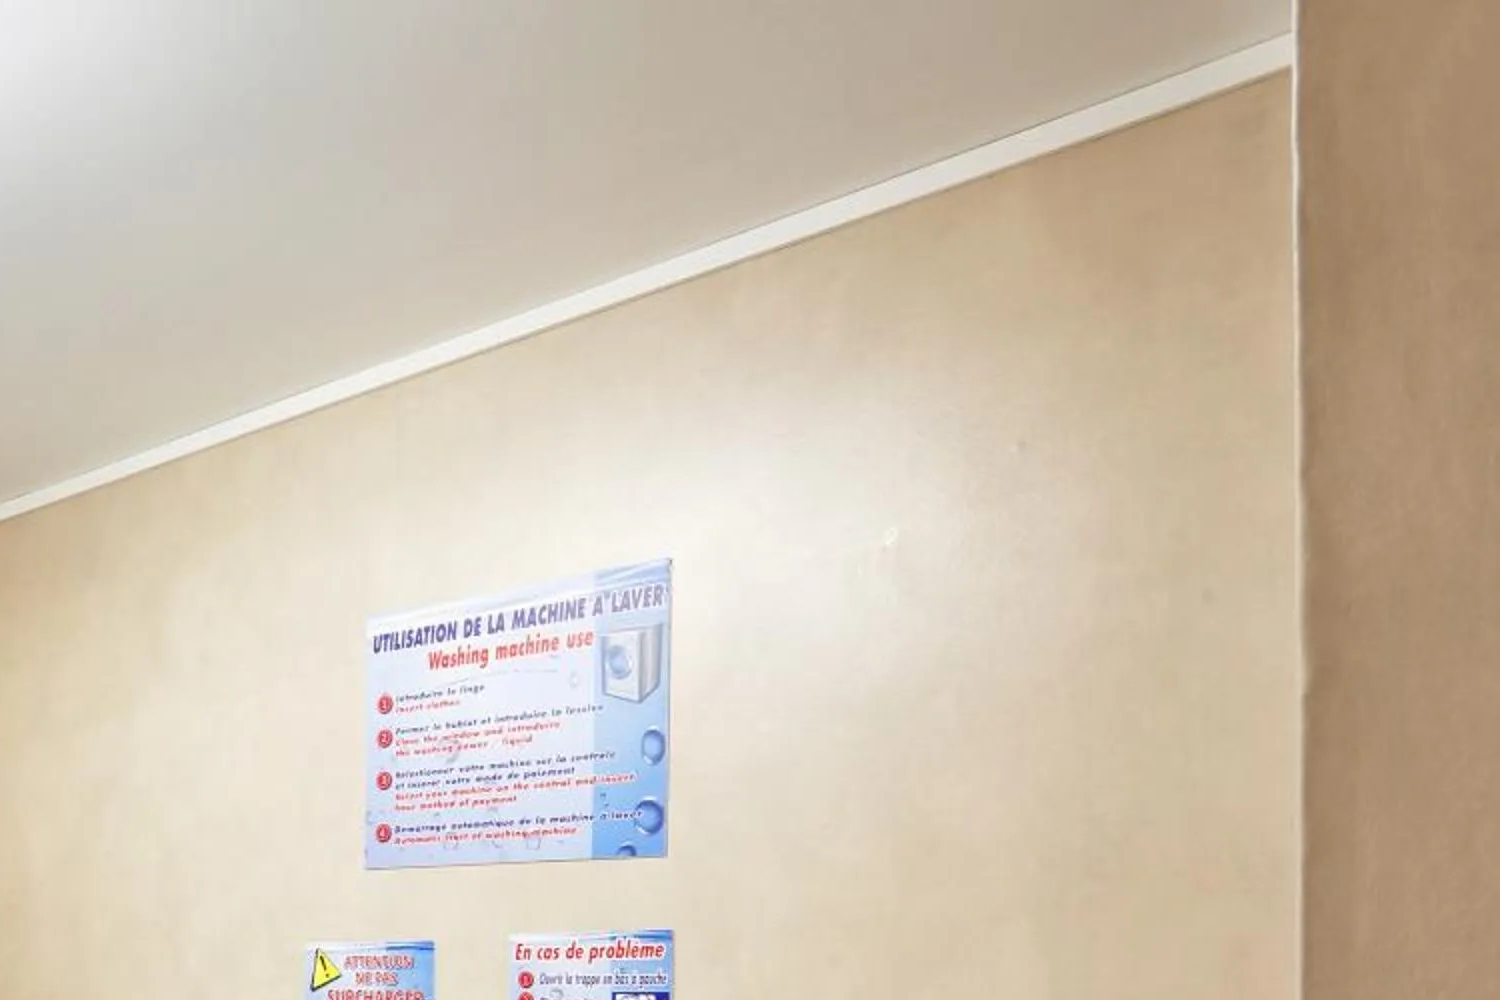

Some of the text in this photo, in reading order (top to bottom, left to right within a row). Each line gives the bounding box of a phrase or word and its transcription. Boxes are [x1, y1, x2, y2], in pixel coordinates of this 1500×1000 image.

[372, 619, 458, 654] UTILISATION
[463, 616, 483, 638] DE
[487, 613, 506, 634] LA
[511, 597, 587, 631] MACHINE
[427, 630, 594, 670] Washing machine use
[515, 943, 531, 960] En
[537, 946, 560, 960] cas
[565, 940, 585, 959] de
